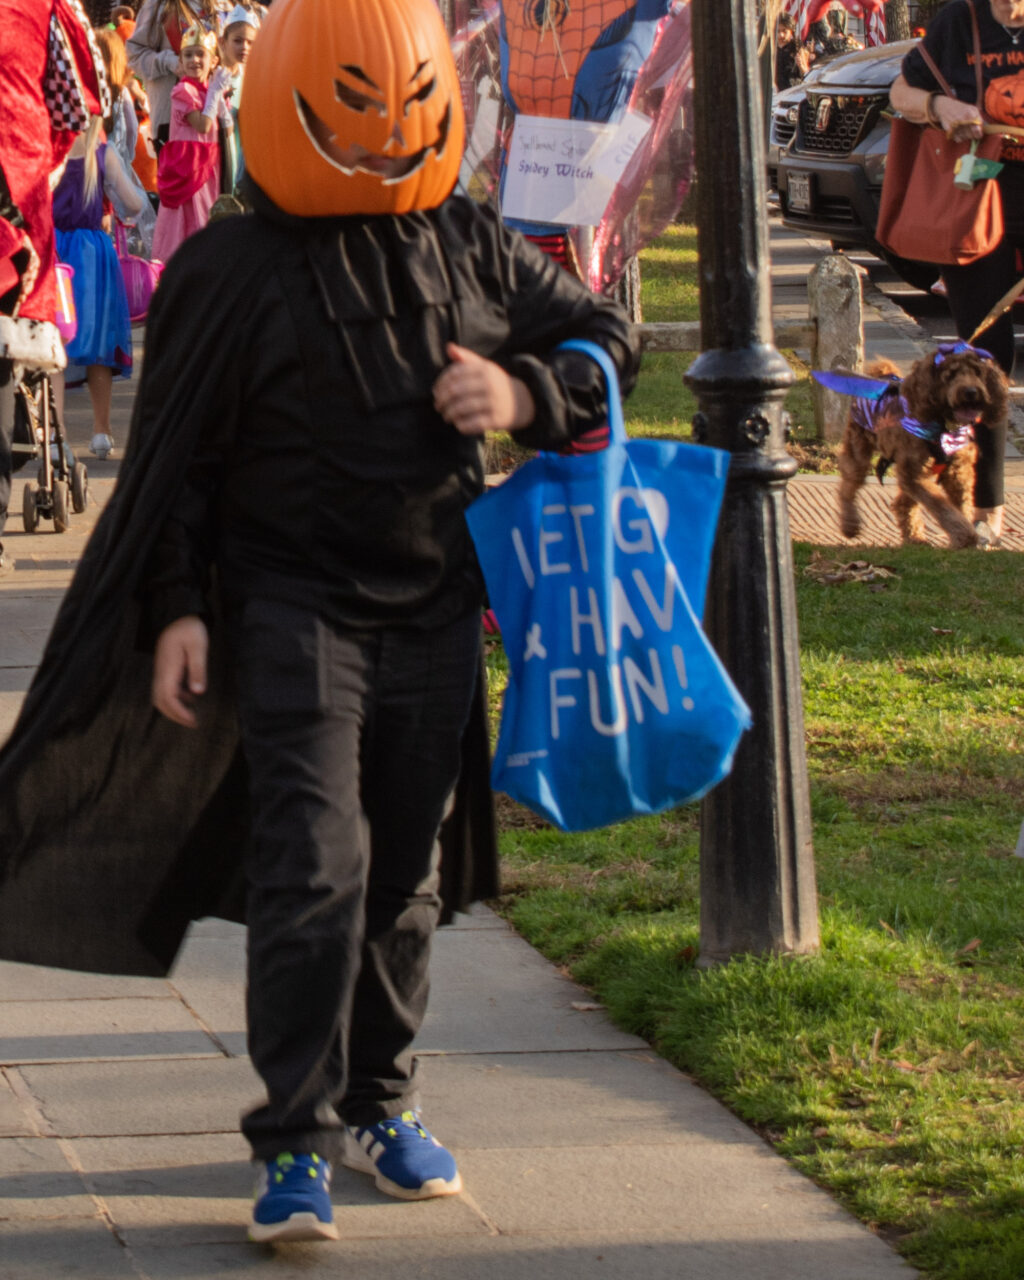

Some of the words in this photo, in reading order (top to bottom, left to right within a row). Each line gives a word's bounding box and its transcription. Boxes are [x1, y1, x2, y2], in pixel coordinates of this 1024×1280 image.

[966, 52, 1003, 69] HPPY
[554, 162, 595, 180] Witch
[569, 562, 677, 657] HAV
[548, 644, 695, 741] FUN!
